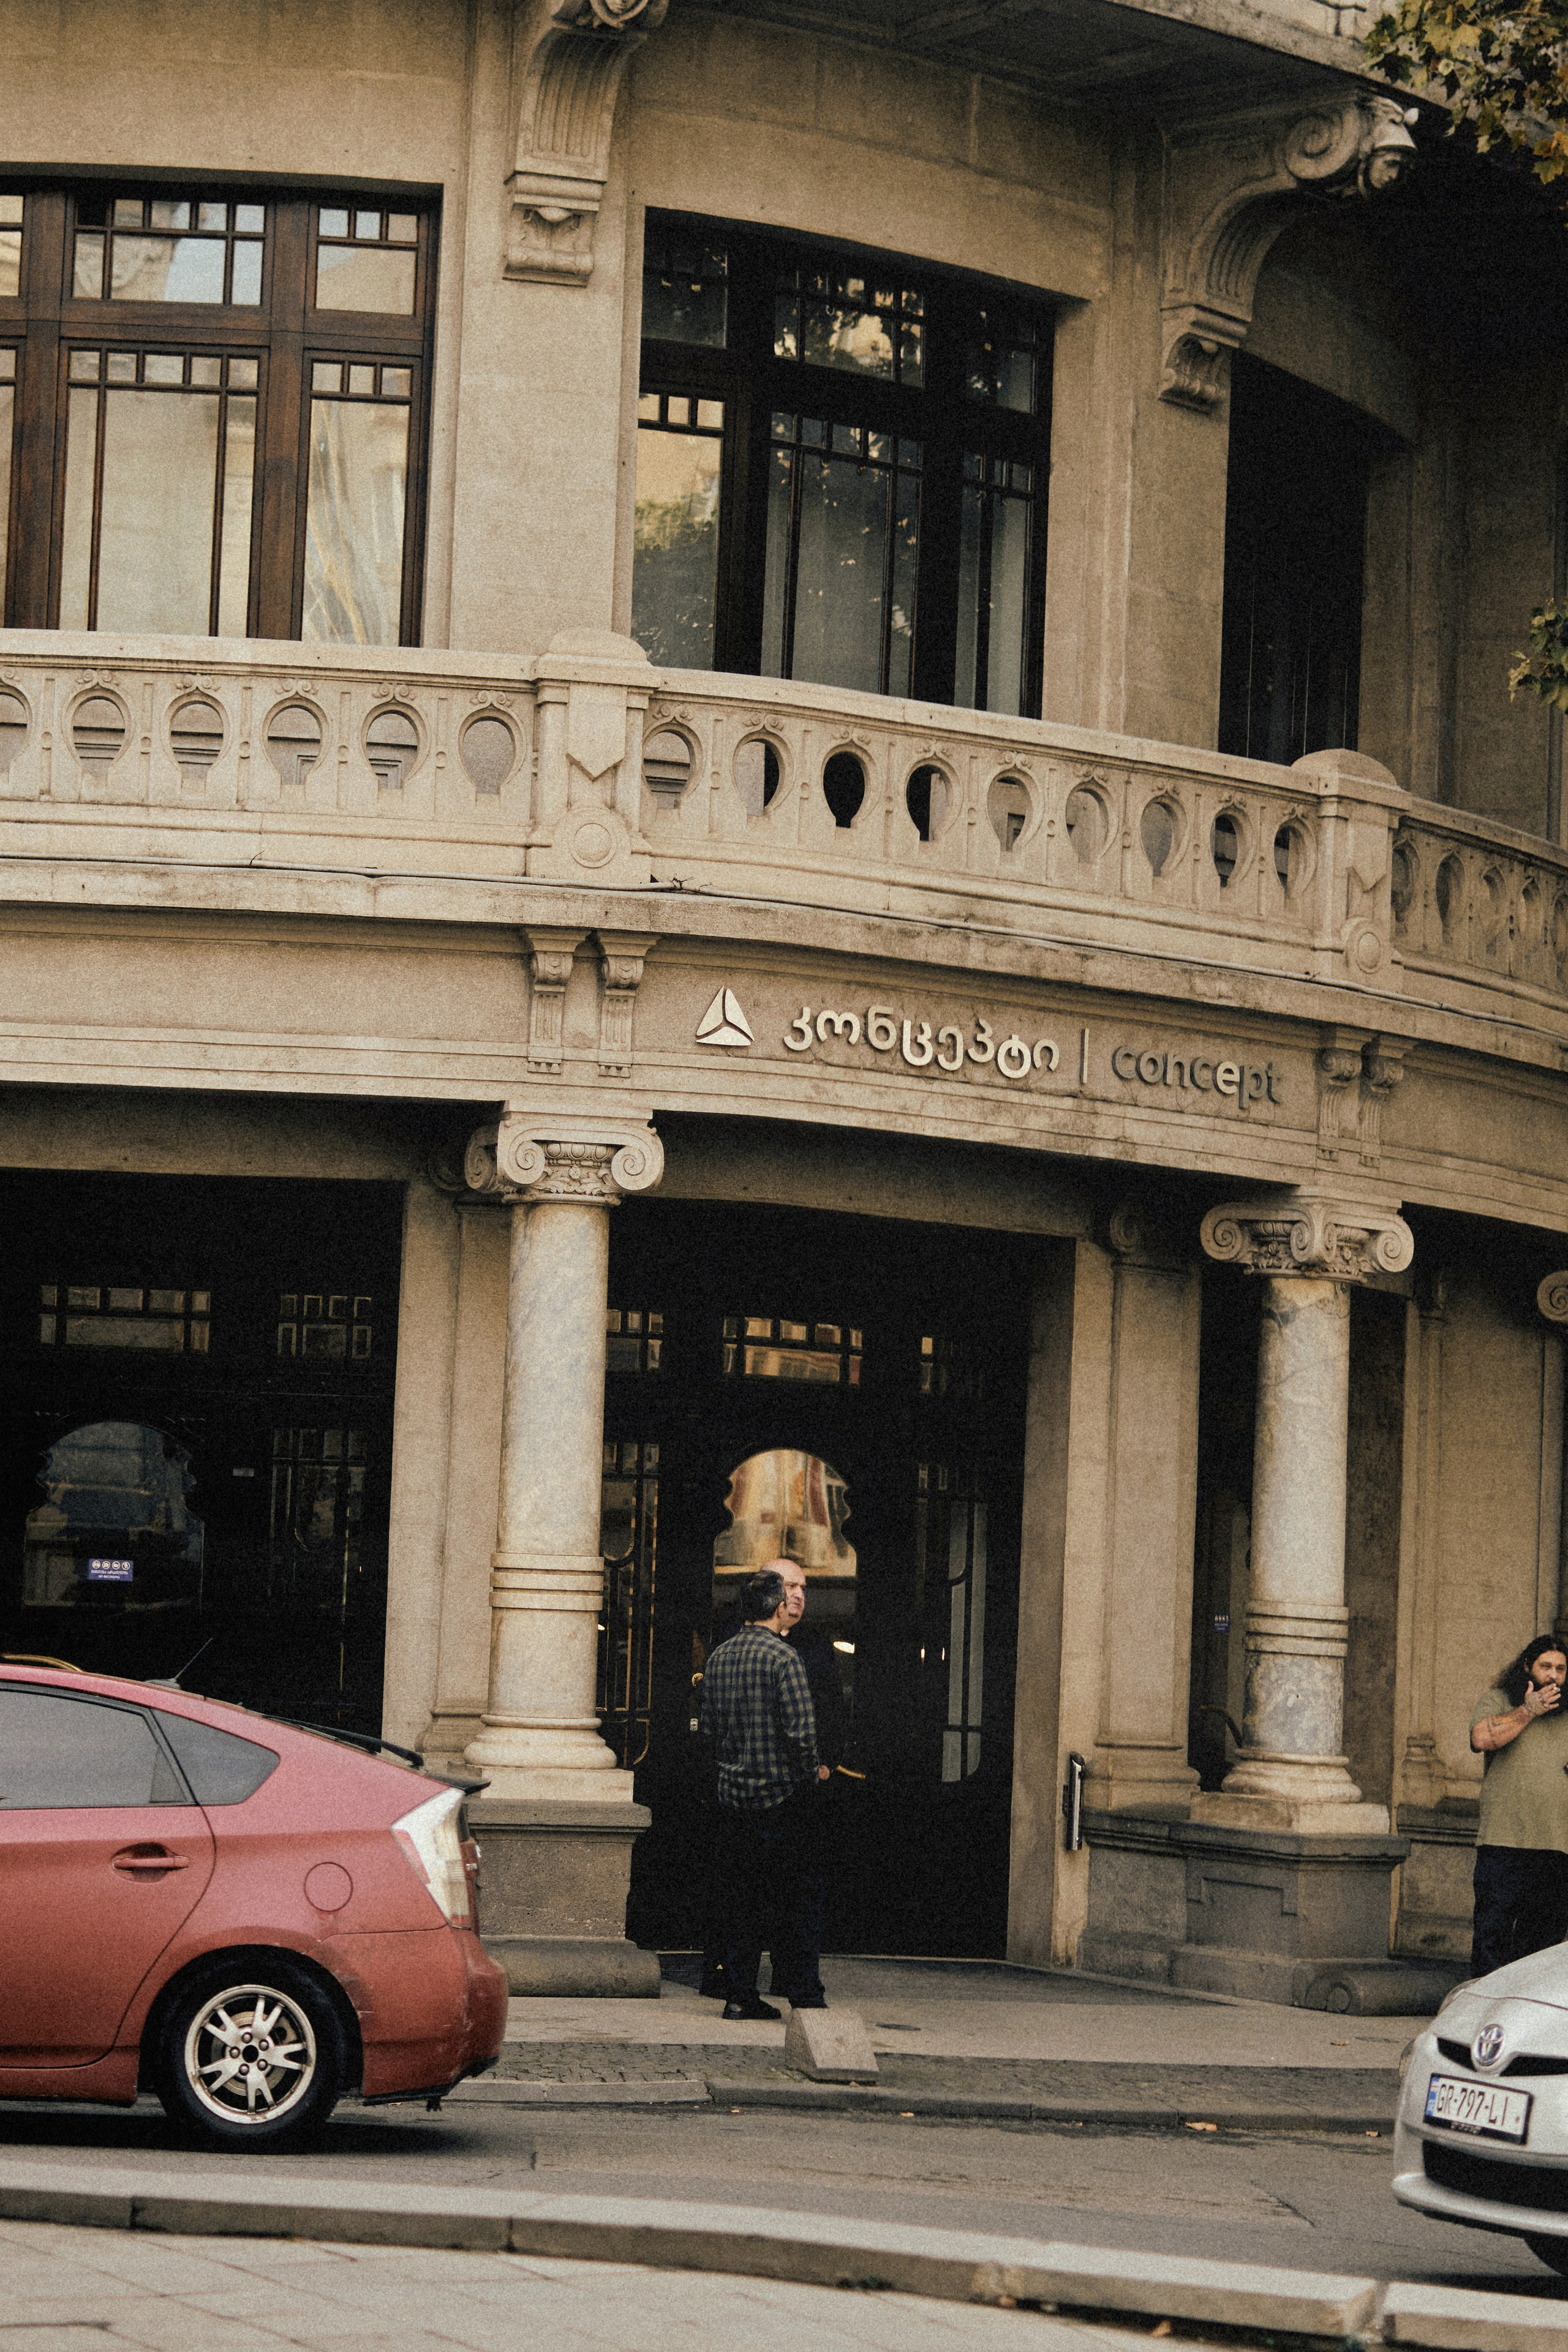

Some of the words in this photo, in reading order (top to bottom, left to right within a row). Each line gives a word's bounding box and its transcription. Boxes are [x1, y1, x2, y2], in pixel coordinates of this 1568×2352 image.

[783, 1005, 1060, 1079] კონცეპტი
[1112, 1045, 1281, 1110] concept
[1437, 2084, 1509, 2126] GR-797-LI
